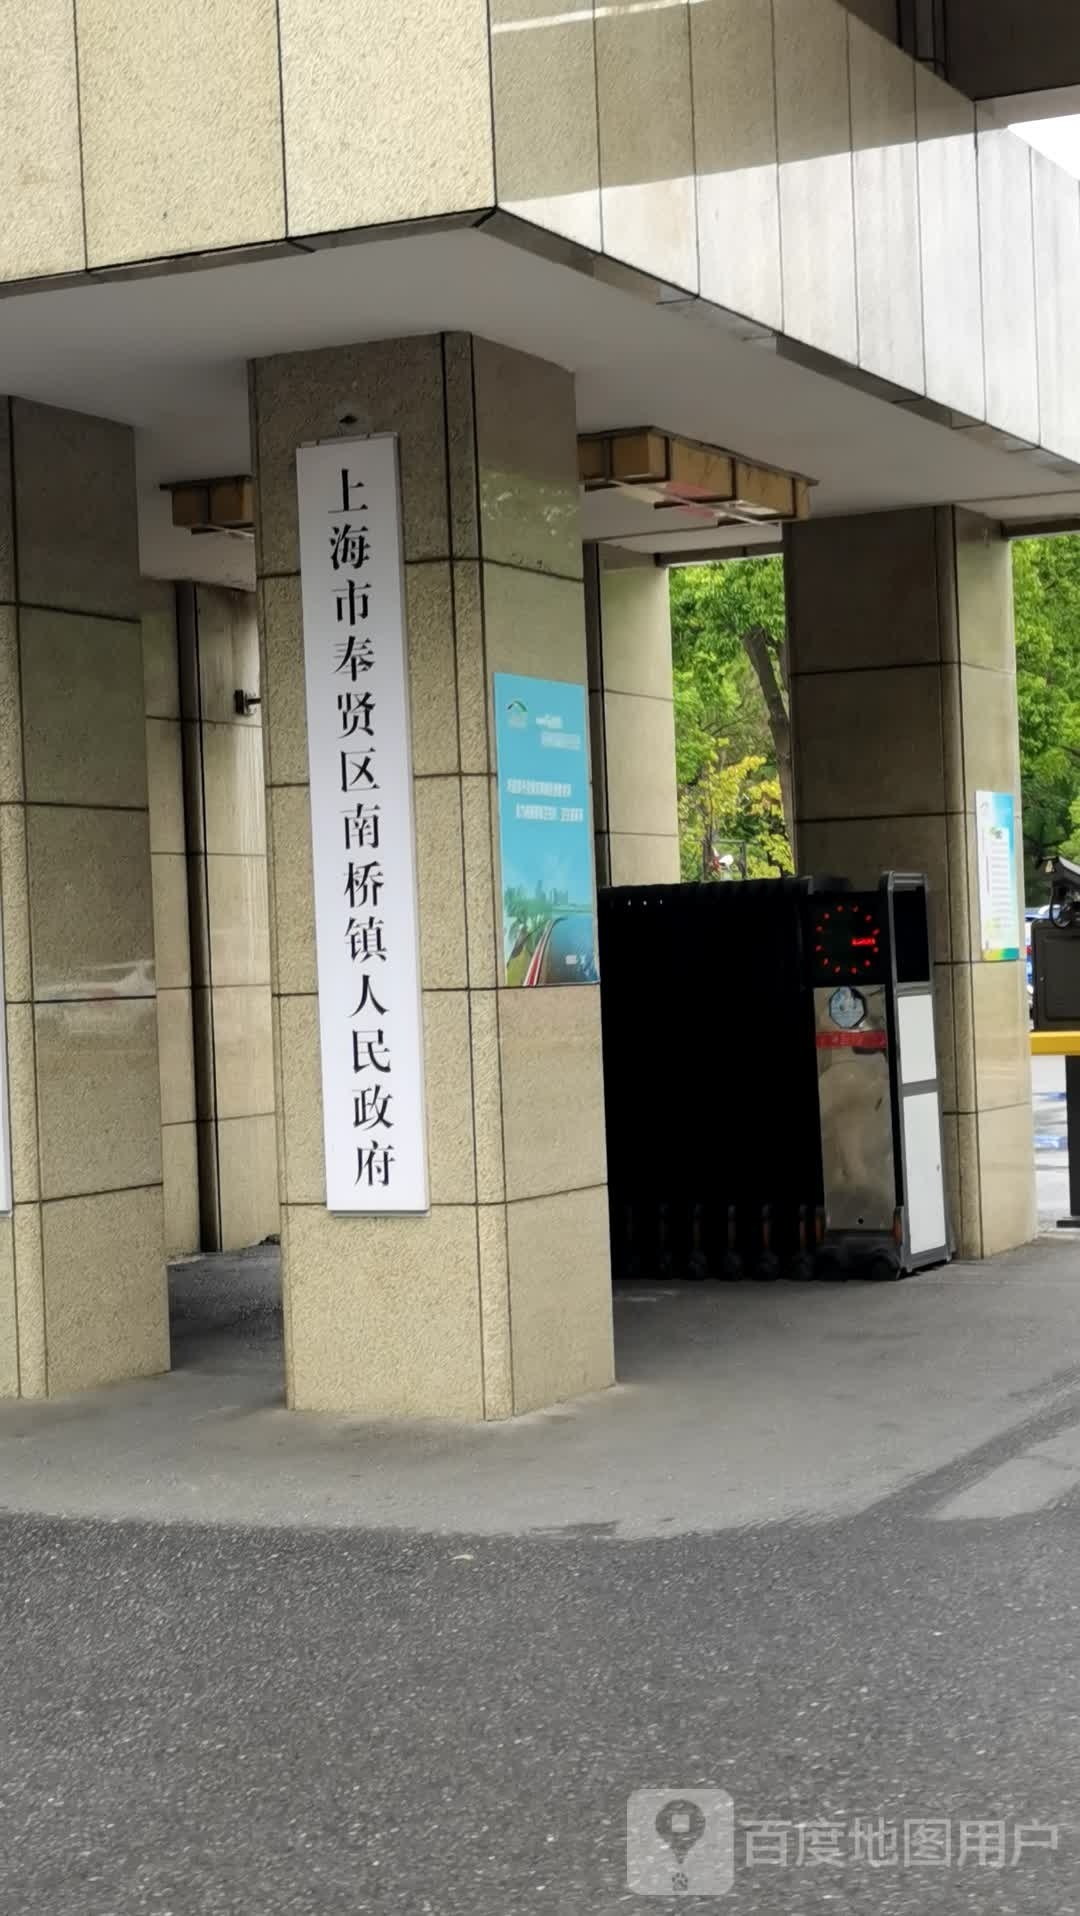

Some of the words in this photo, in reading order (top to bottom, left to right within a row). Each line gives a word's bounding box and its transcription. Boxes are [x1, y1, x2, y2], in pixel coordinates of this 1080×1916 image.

[328, 468, 395, 1187] 上海市奉贤区南桥镇人民政府
